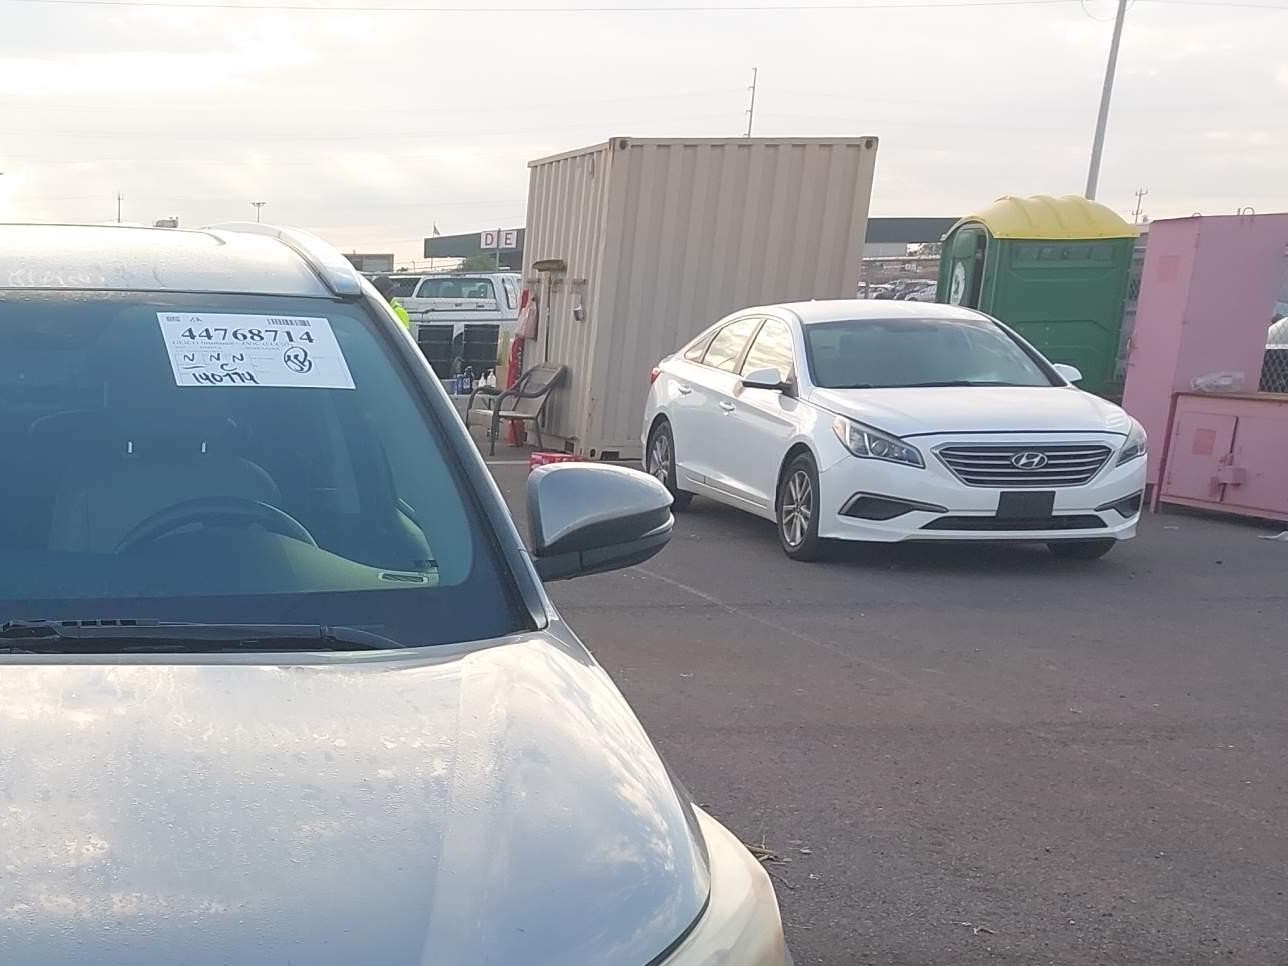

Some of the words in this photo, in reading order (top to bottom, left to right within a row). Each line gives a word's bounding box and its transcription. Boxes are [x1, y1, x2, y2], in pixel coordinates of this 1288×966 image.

[484, 232, 494, 246] D
[504, 232, 513, 246] E
[181, 327, 316, 344] 44768714
[183, 352, 195, 362] N
[209, 352, 221, 362] N
[232, 352, 245, 363] N
